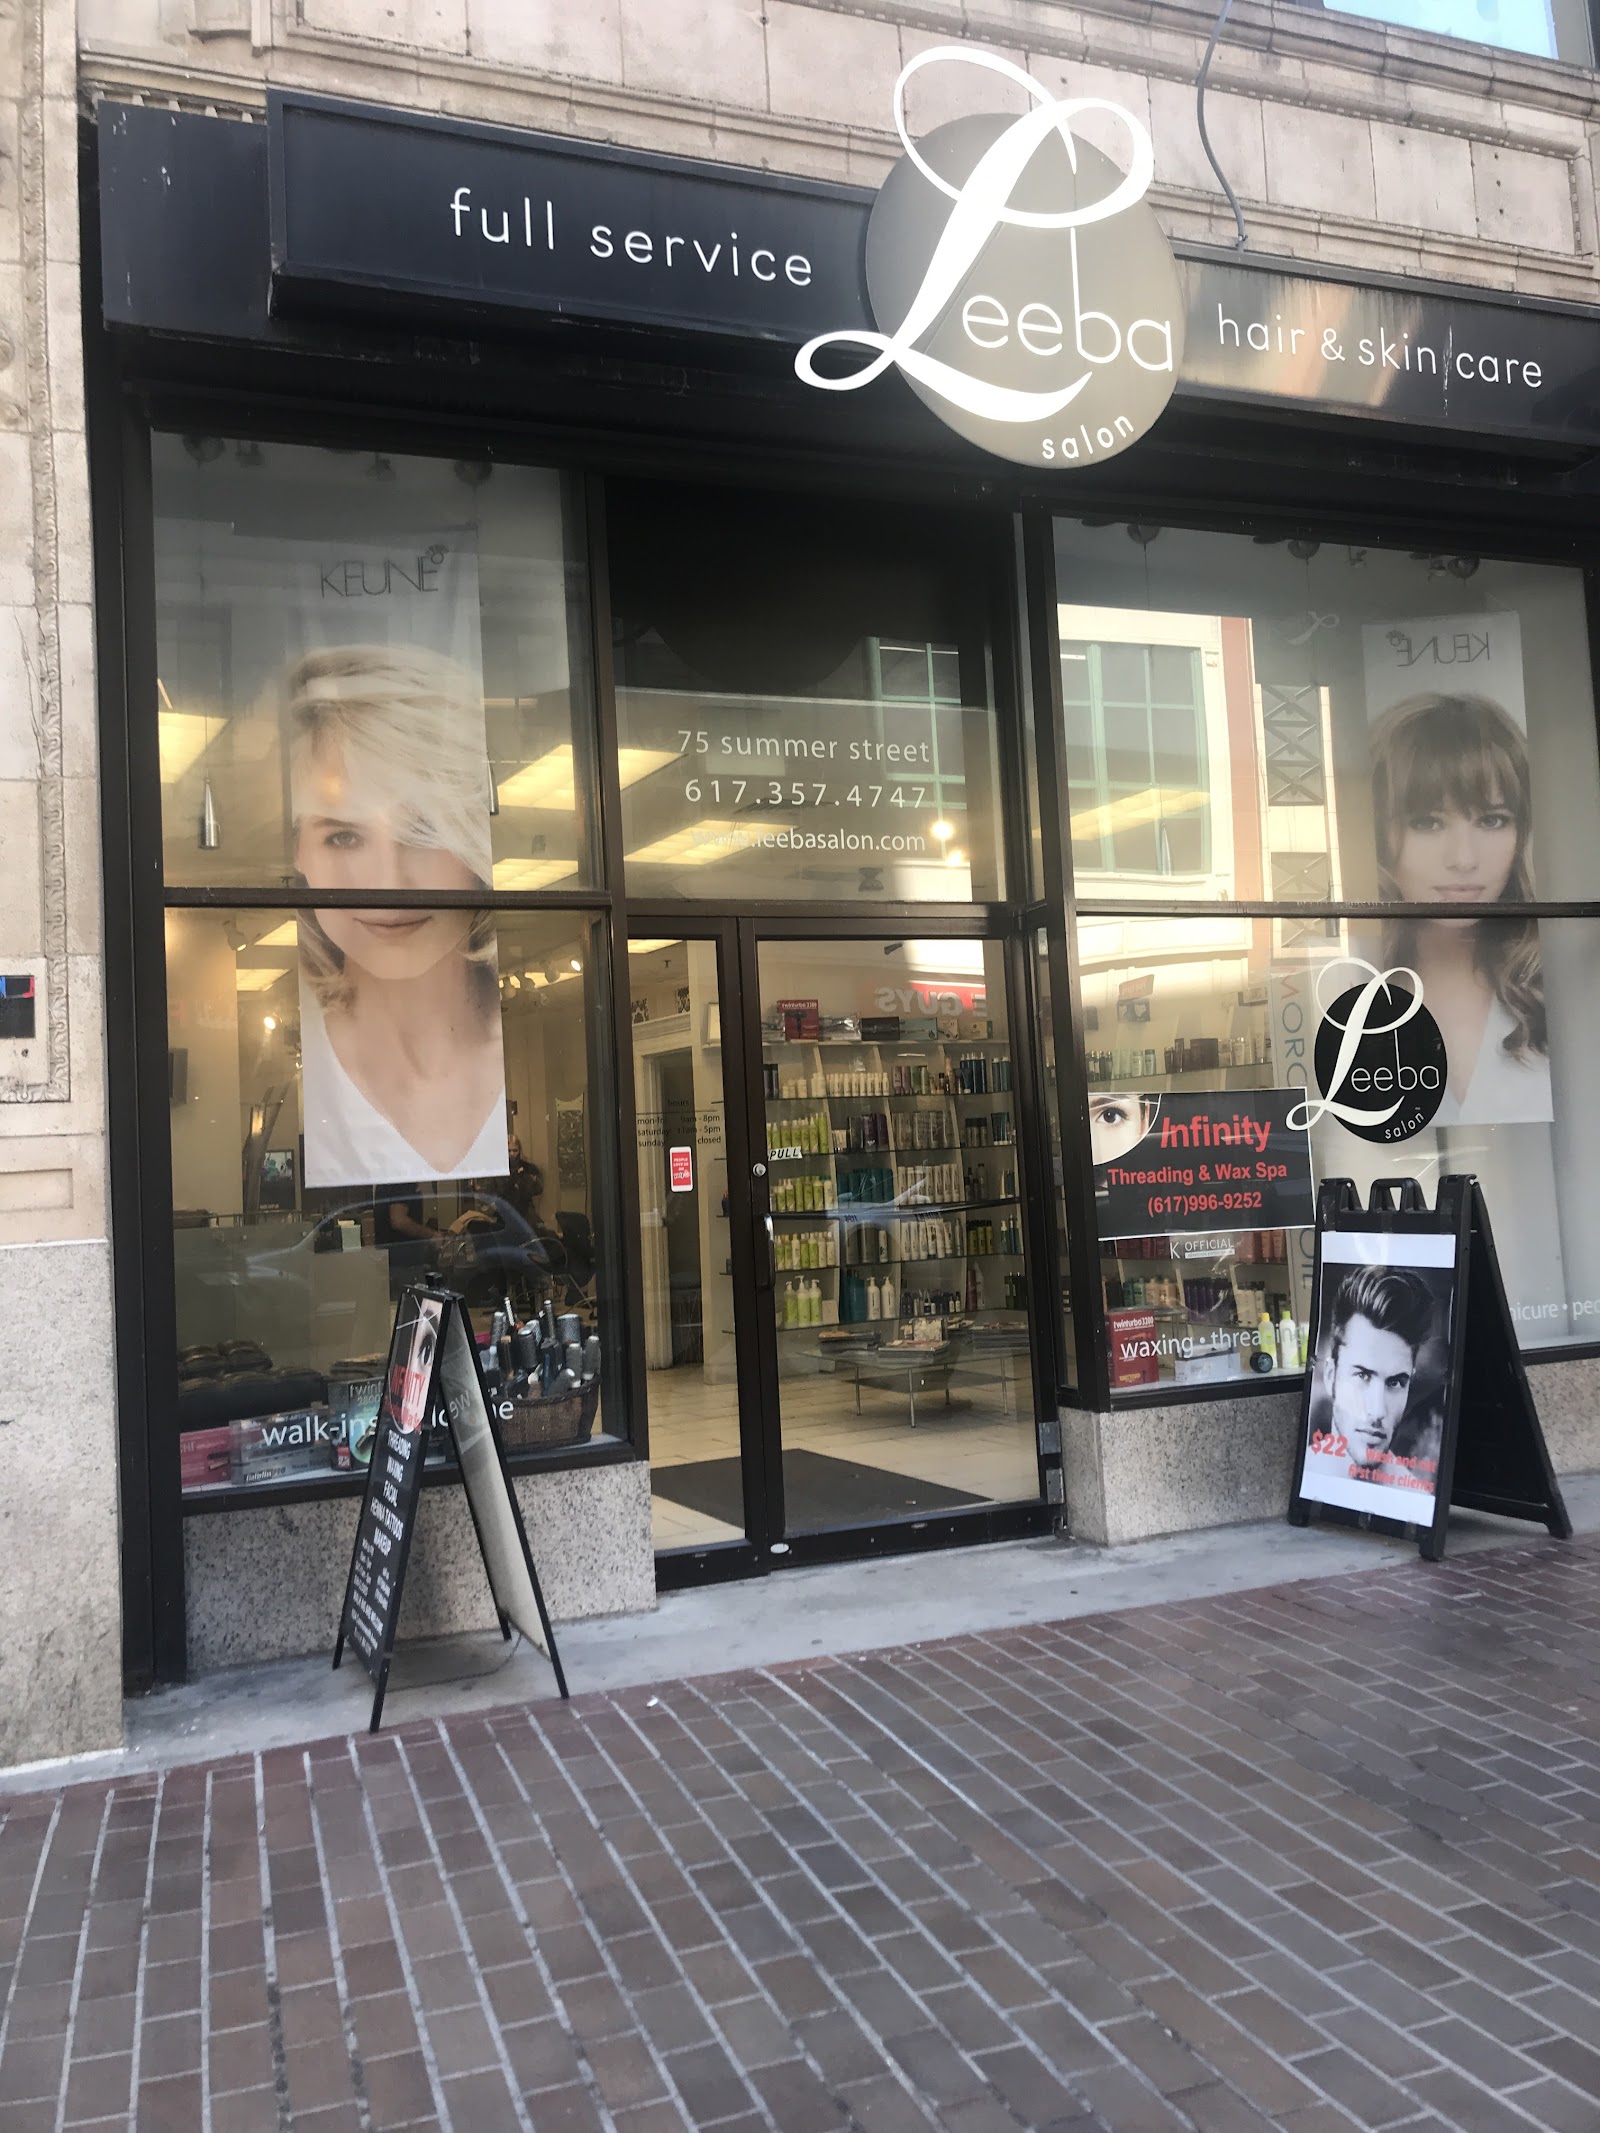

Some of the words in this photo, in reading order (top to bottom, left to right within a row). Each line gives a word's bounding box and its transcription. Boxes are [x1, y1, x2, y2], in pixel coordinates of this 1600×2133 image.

[450, 187, 555, 249] full
[590, 225, 811, 286] service
[794, 45, 1173, 422] Leeba
[1218, 303, 1305, 354] hair
[1321, 328, 1345, 361] &
[1359, 327, 1436, 374] skin
[1456, 352, 1542, 388] care
[1042, 415, 1135, 460] salon
[320, 556, 439, 598] KEUNE
[677, 730, 709, 753] 75
[721, 736, 838, 759] summer
[850, 740, 930, 763] street
[685, 779, 926, 809] 617.357.4747
[690, 827, 926, 851] www.leebasalon.com
[1286, 957, 1440, 1130] Leeba
[638, 1127, 671, 1137] saturday
[704, 1125, 721, 1135] 5pm
[703, 1114, 720, 1124] 8pm
[1161, 1115, 1271, 1152] Infinity
[1385, 1112, 1425, 1139] salon
[638, 1138, 666, 1148] sunday
[697, 1135, 722, 1144] closed
[769, 1150, 799, 1160] PULL
[1108, 1166, 1194, 1186] Threading
[1199, 1165, 1210, 1181] &
[1215, 1164, 1251, 1181] Wax
[1256, 1162, 1287, 1181] Spa
[1148, 1191, 1262, 1217] (617)996-9252
[1184, 1238, 1235, 1252] OFFICIAL
[1121, 1333, 1194, 1360] waxing
[261, 1413, 379, 1447] walk-ins
[1311, 1428, 1348, 1458] $22
[1396, 1455, 1418, 1469] and
[1348, 1463, 1370, 1480] first
[1397, 1475, 1435, 1493] clients
